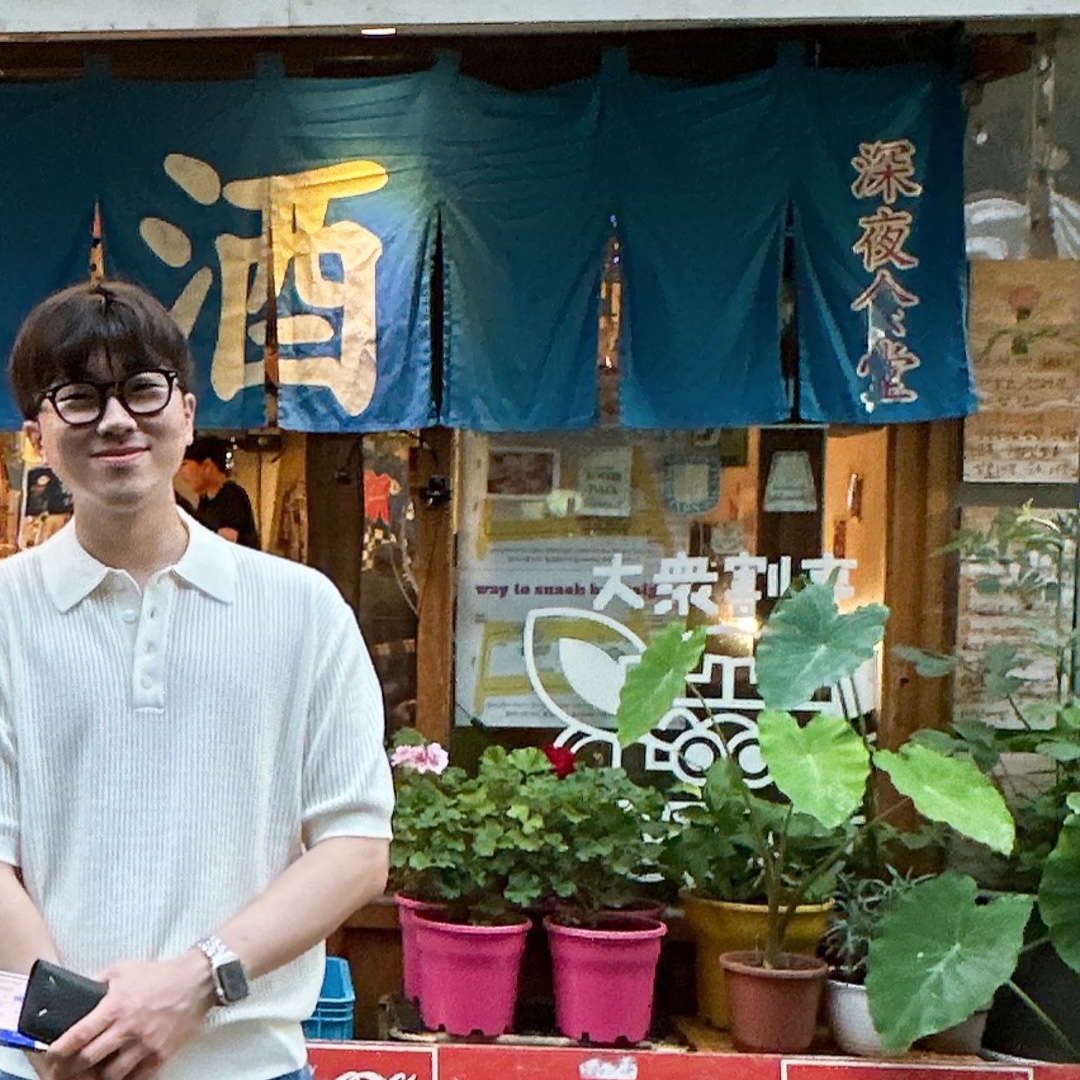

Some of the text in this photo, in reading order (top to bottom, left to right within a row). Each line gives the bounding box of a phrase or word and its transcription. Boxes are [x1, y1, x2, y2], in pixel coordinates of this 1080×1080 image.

[139, 153, 389, 416] 酒
[476, 584, 508, 598] way
[514, 583, 530, 596] to
[535, 583, 585, 596] snack
